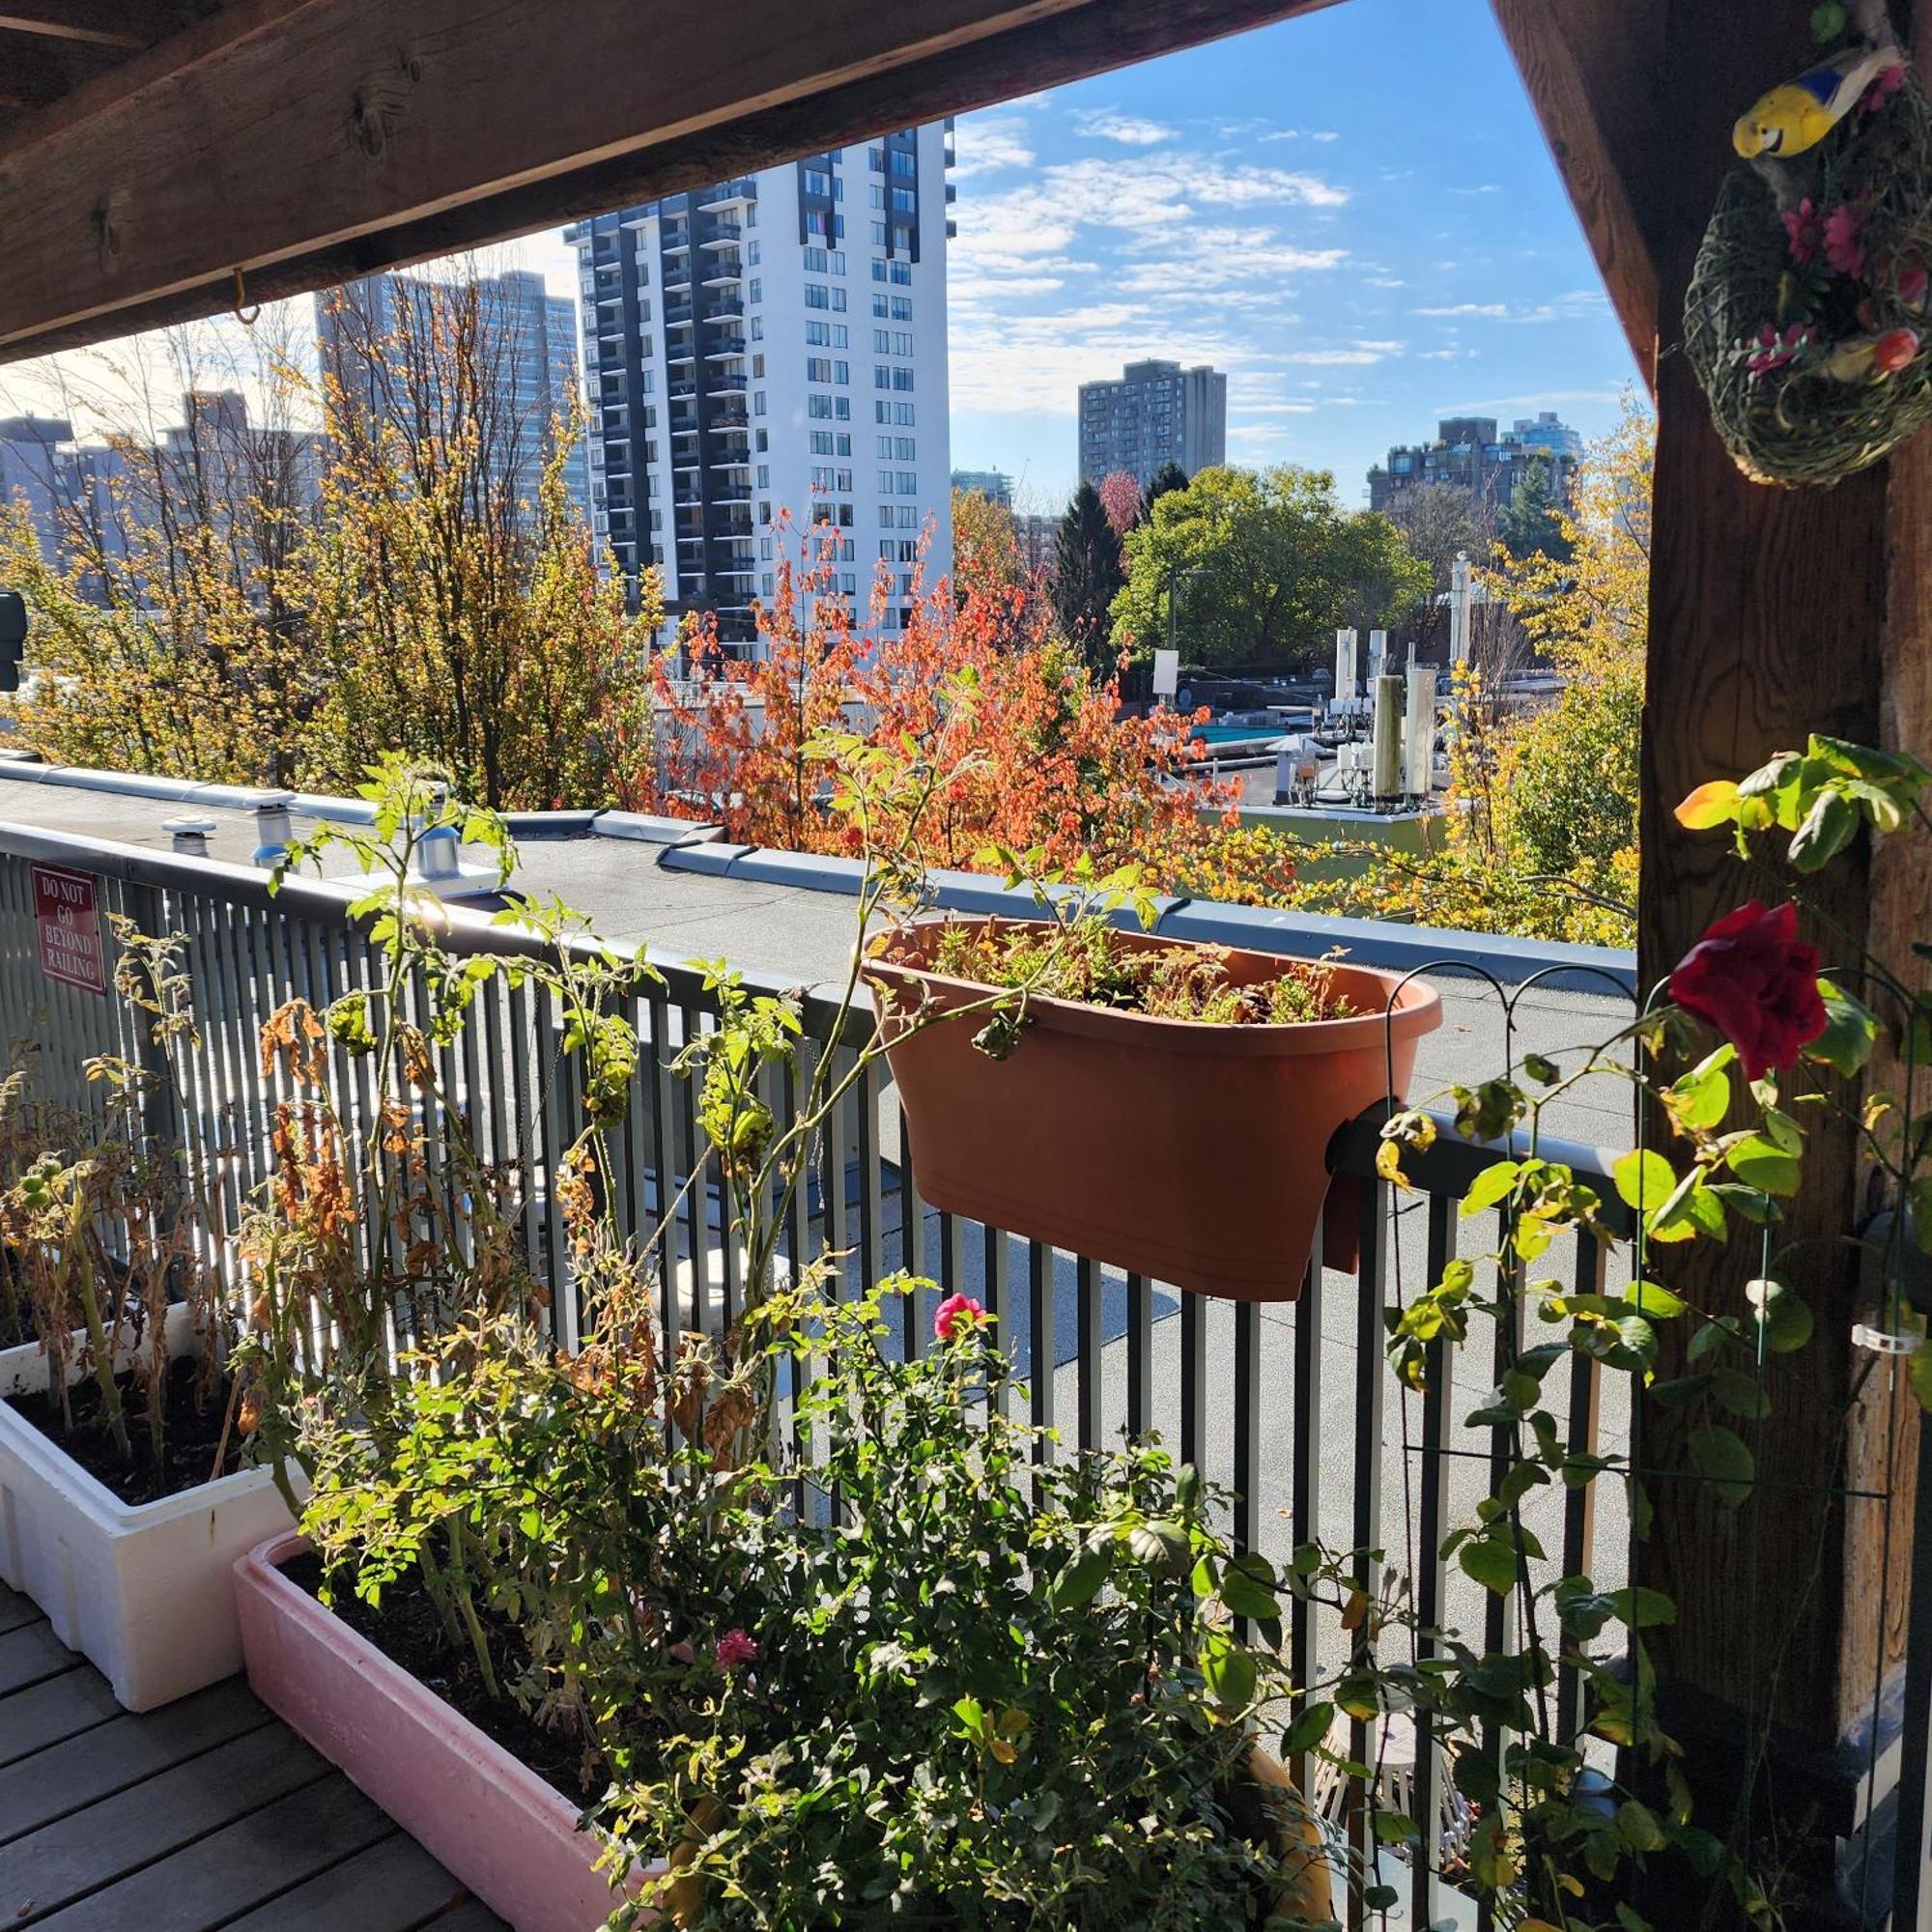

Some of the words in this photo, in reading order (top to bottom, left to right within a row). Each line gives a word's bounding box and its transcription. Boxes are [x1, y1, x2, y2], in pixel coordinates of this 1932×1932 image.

[42, 876, 58, 897] DO
[60, 882, 84, 905] NOT
[57, 904, 73, 925] GO
[45, 923, 92, 955] BEYOND
[46, 948, 95, 980] RAILING
